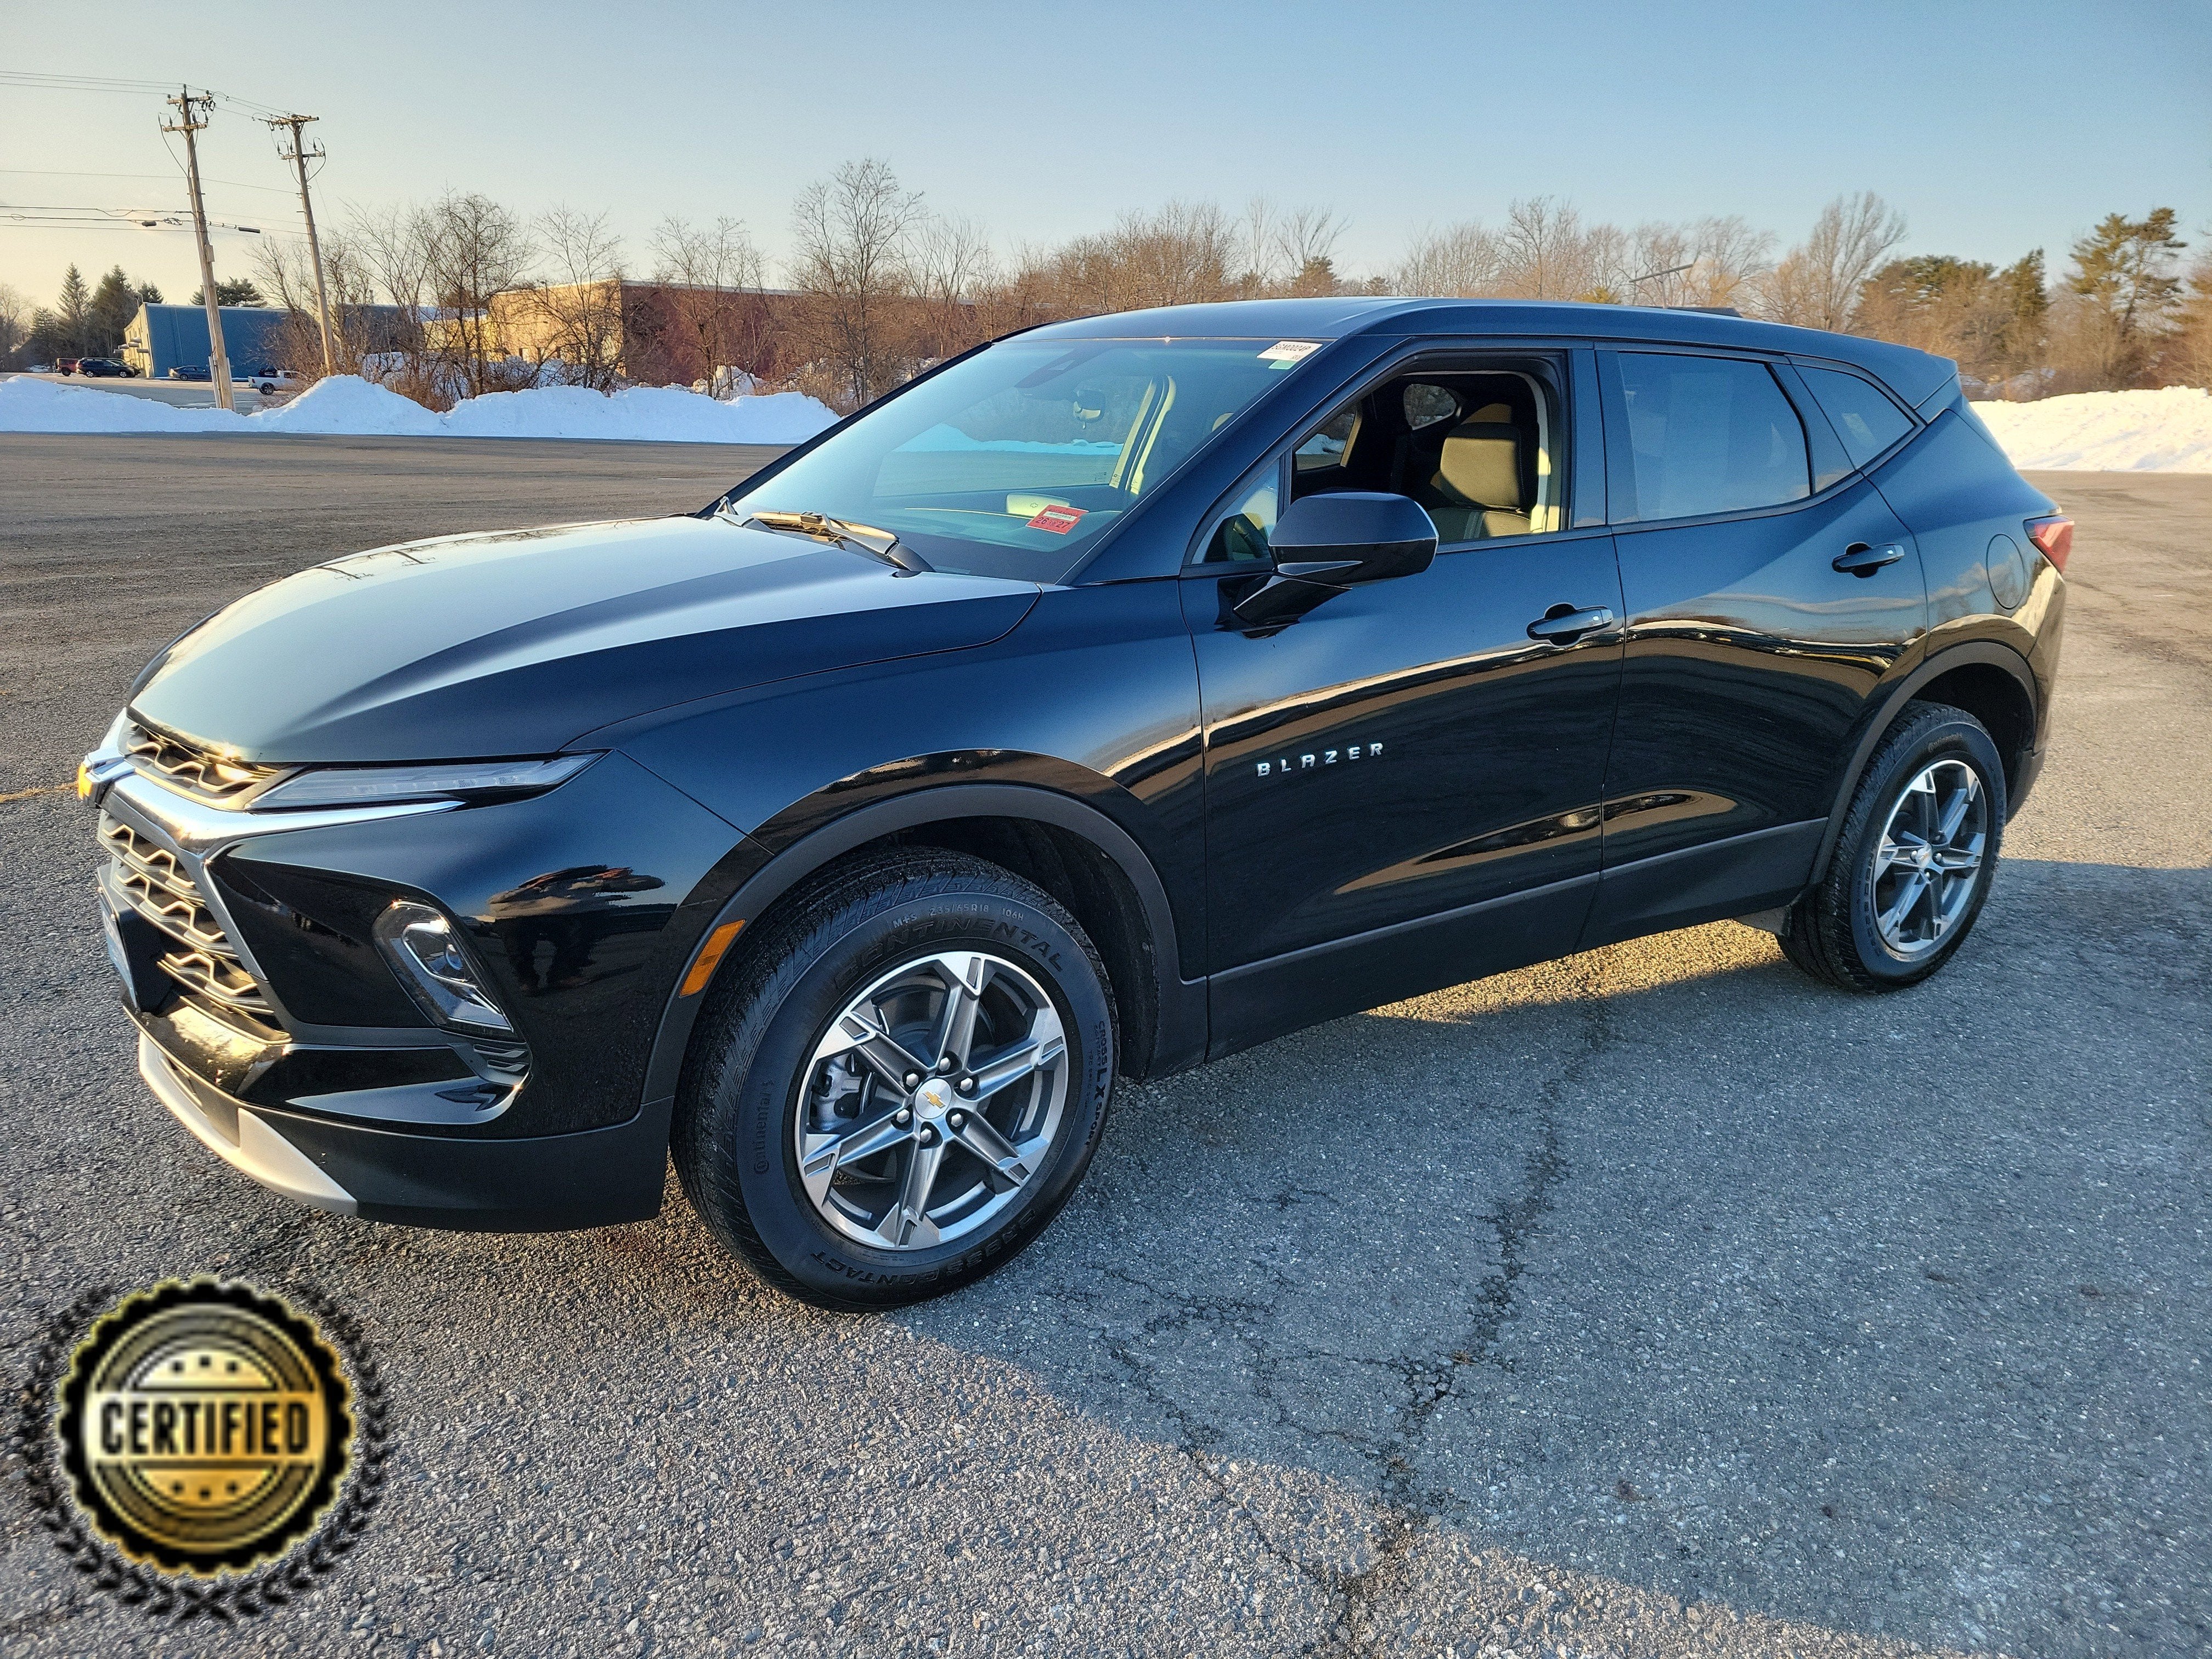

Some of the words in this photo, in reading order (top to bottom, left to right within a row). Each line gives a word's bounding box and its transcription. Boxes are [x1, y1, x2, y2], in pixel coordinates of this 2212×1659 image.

[1257, 743, 1384, 777] BLAZER
[893, 913, 918, 928] M+S
[1001, 907, 1024, 921] 106H
[834, 917, 1063, 988] CONTINENTAL
[1098, 1020, 1108, 1065] CROSS
